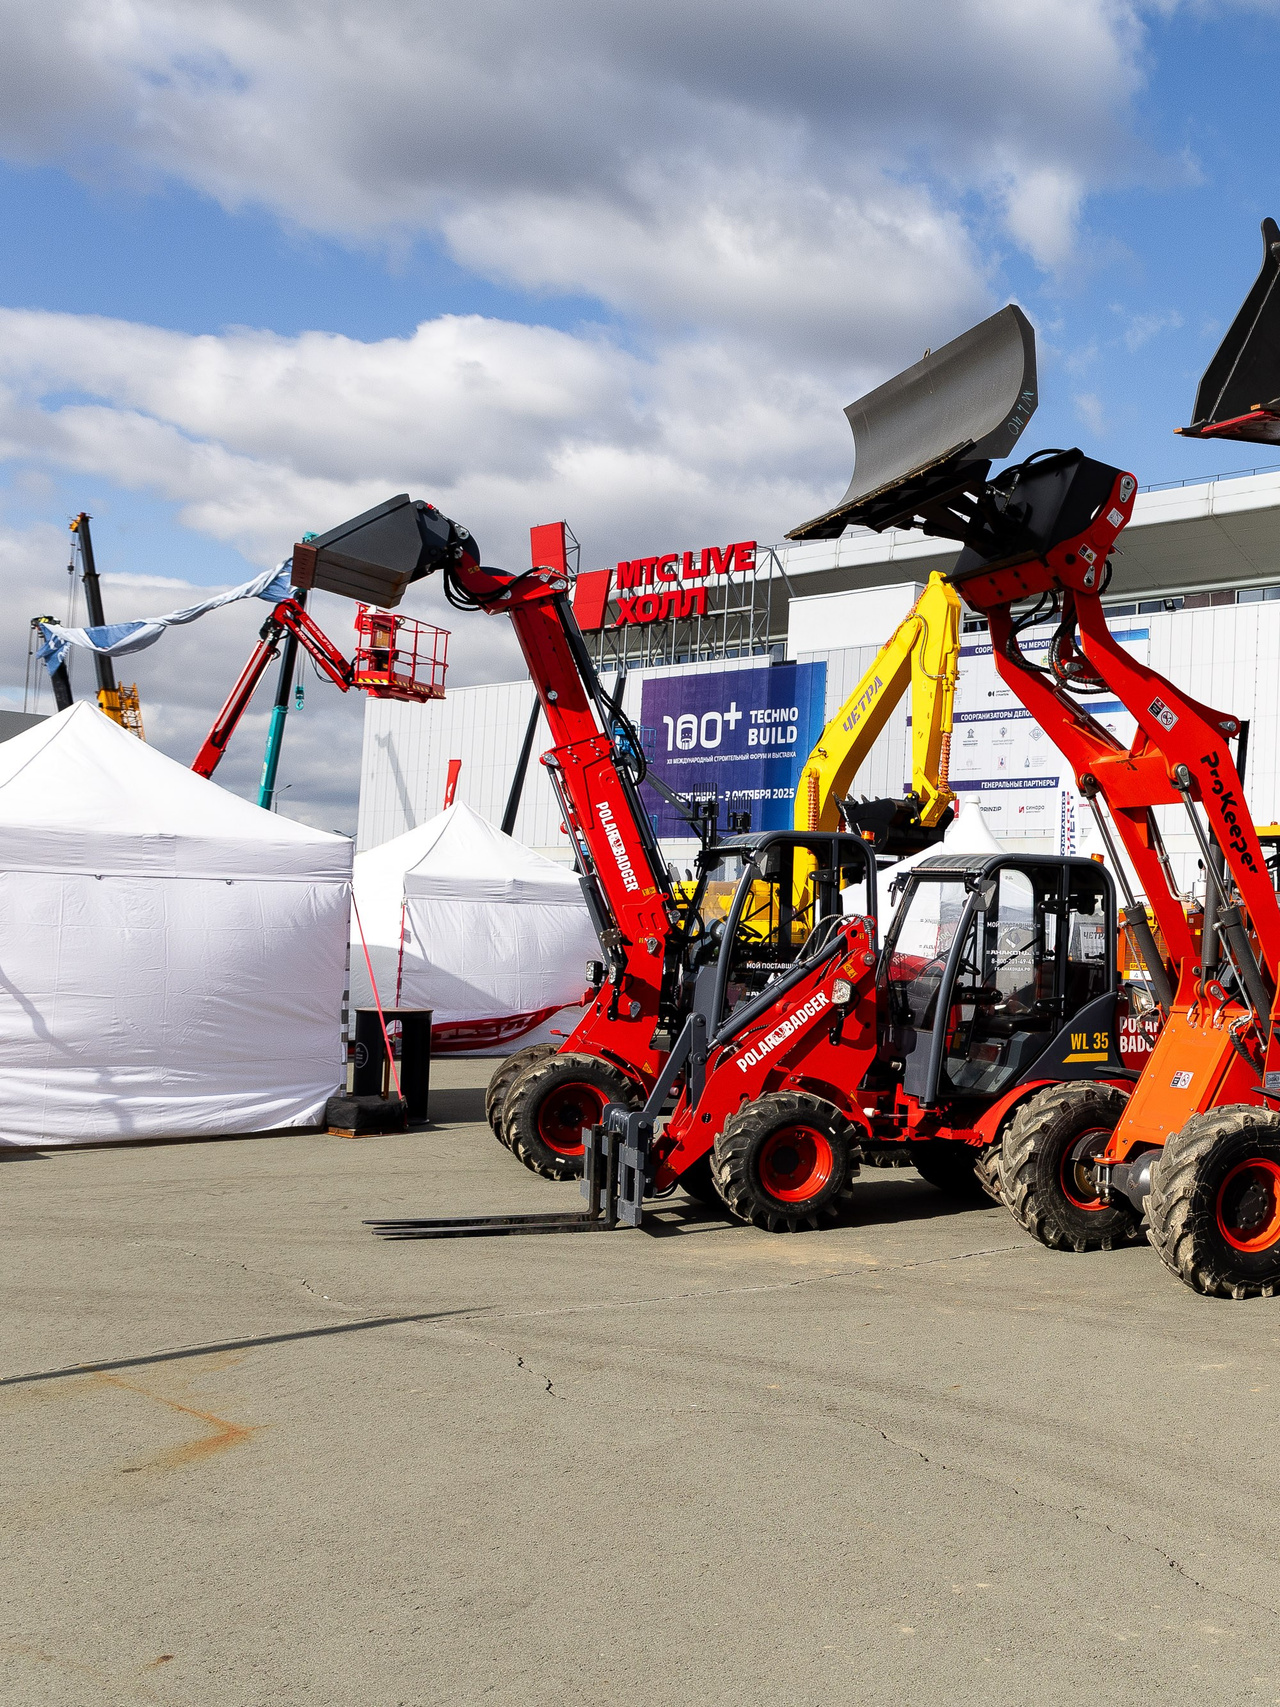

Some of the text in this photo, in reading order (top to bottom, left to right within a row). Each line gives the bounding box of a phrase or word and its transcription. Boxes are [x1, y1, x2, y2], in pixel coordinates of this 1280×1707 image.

[617, 541, 757, 590] МТС LIVE
[615, 586, 708, 625] ХОЛЛ
[843, 676, 883, 732] ЧЕТРА
[749, 707, 799, 724] TECHNO
[748, 725, 798, 746] BUILD
[773, 787, 795, 799] 2025
[981, 779, 1056, 789] ГЕНЕРАЛЬНЫЕ ПАРТНЕРЫ
[613, 848, 640, 892] BADGER
[1083, 931, 1105, 940] ЧЕТР
[736, 992, 830, 1073] POLAR BADGER
[1070, 1031, 1109, 1050] WL 35
